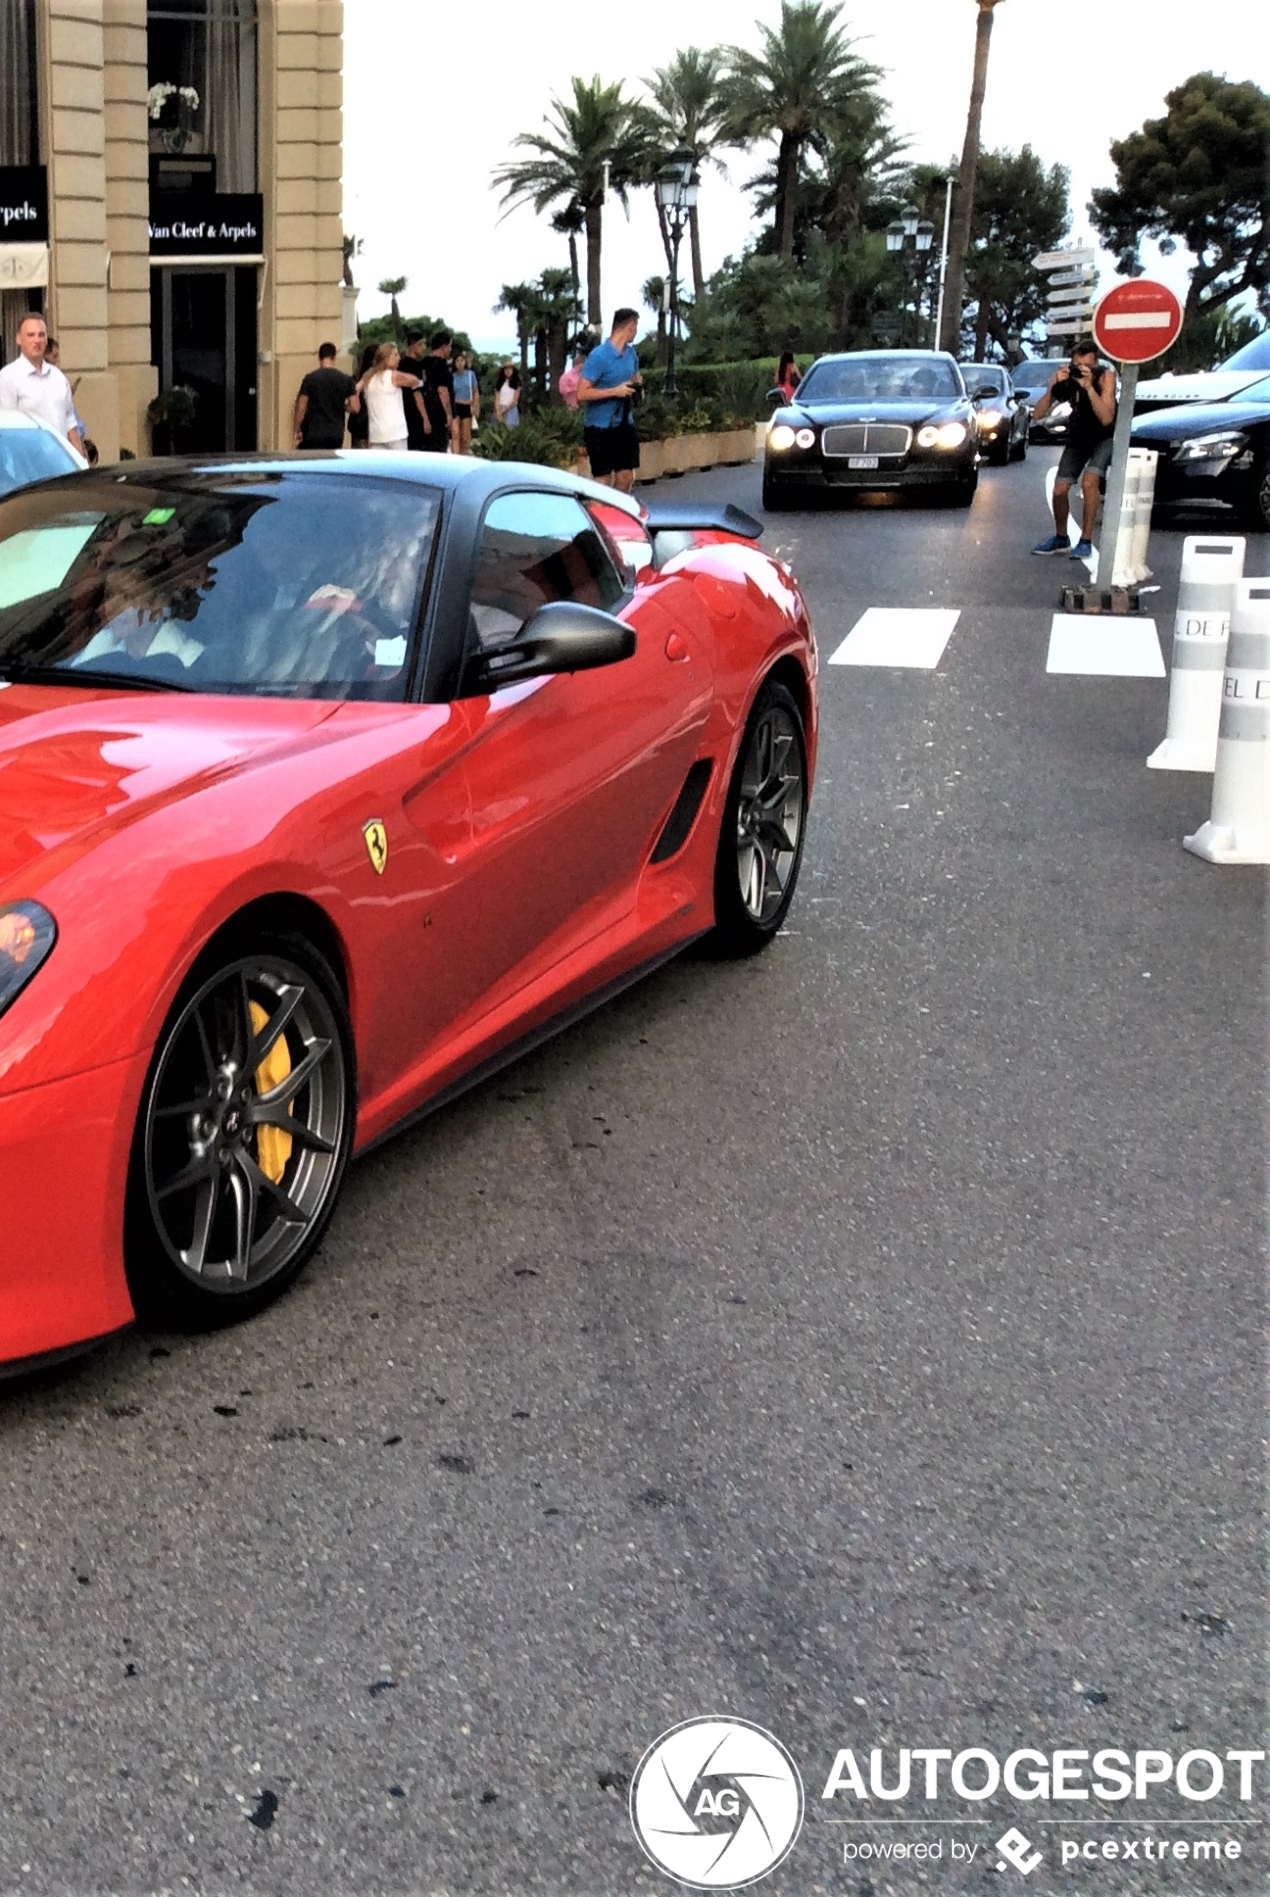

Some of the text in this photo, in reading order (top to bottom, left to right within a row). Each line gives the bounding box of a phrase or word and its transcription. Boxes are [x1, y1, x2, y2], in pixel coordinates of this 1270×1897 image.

[148, 221, 257, 243] Van Cleef & Arpels
[1186, 619, 1212, 637] DE
[1223, 677, 1244, 699] EL
